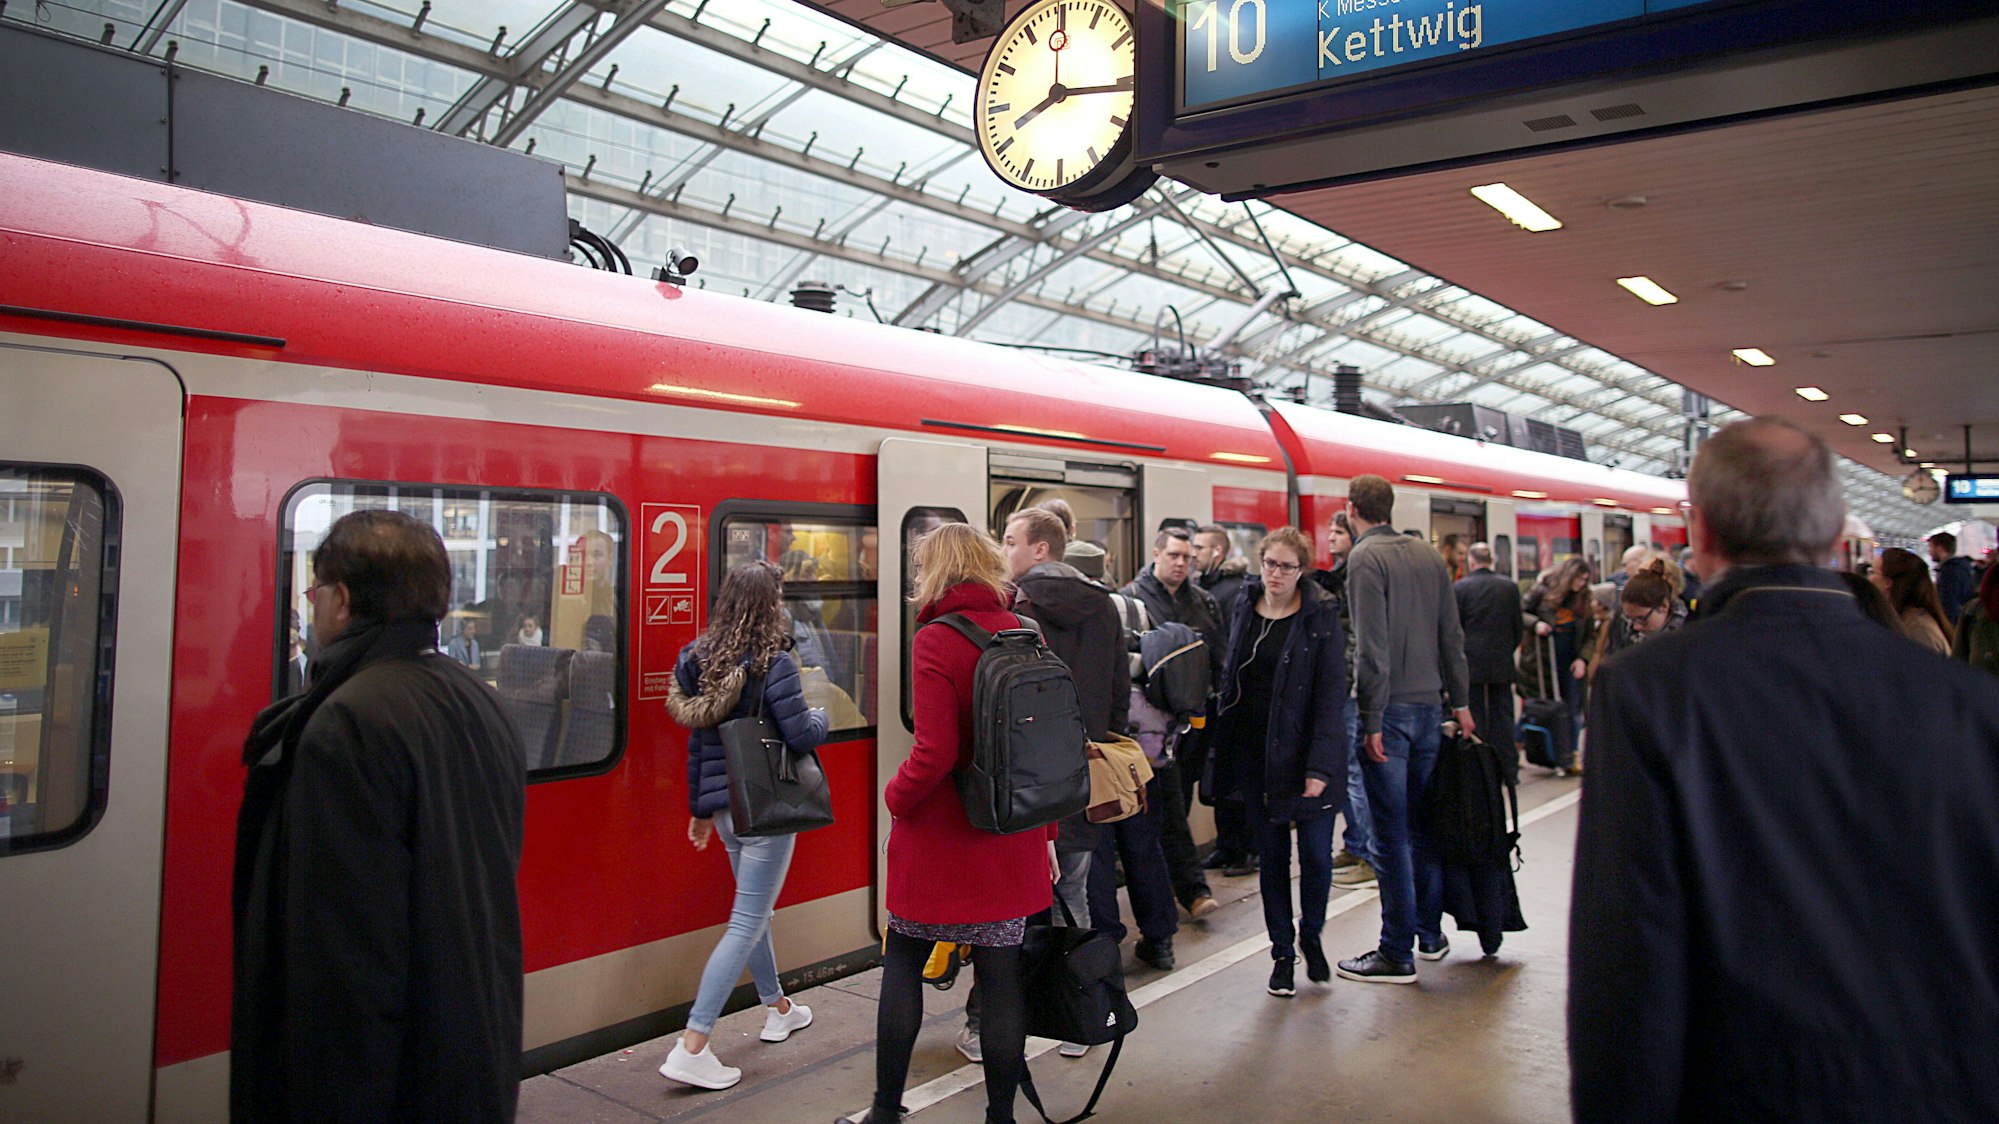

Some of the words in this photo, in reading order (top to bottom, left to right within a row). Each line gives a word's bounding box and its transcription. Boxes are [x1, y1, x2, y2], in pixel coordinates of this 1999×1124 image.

[1191, 0, 1266, 73] 10
[1318, 0, 1331, 21] K
[1318, 2, 1482, 69] Kettwig
[650, 511, 687, 584] 2
